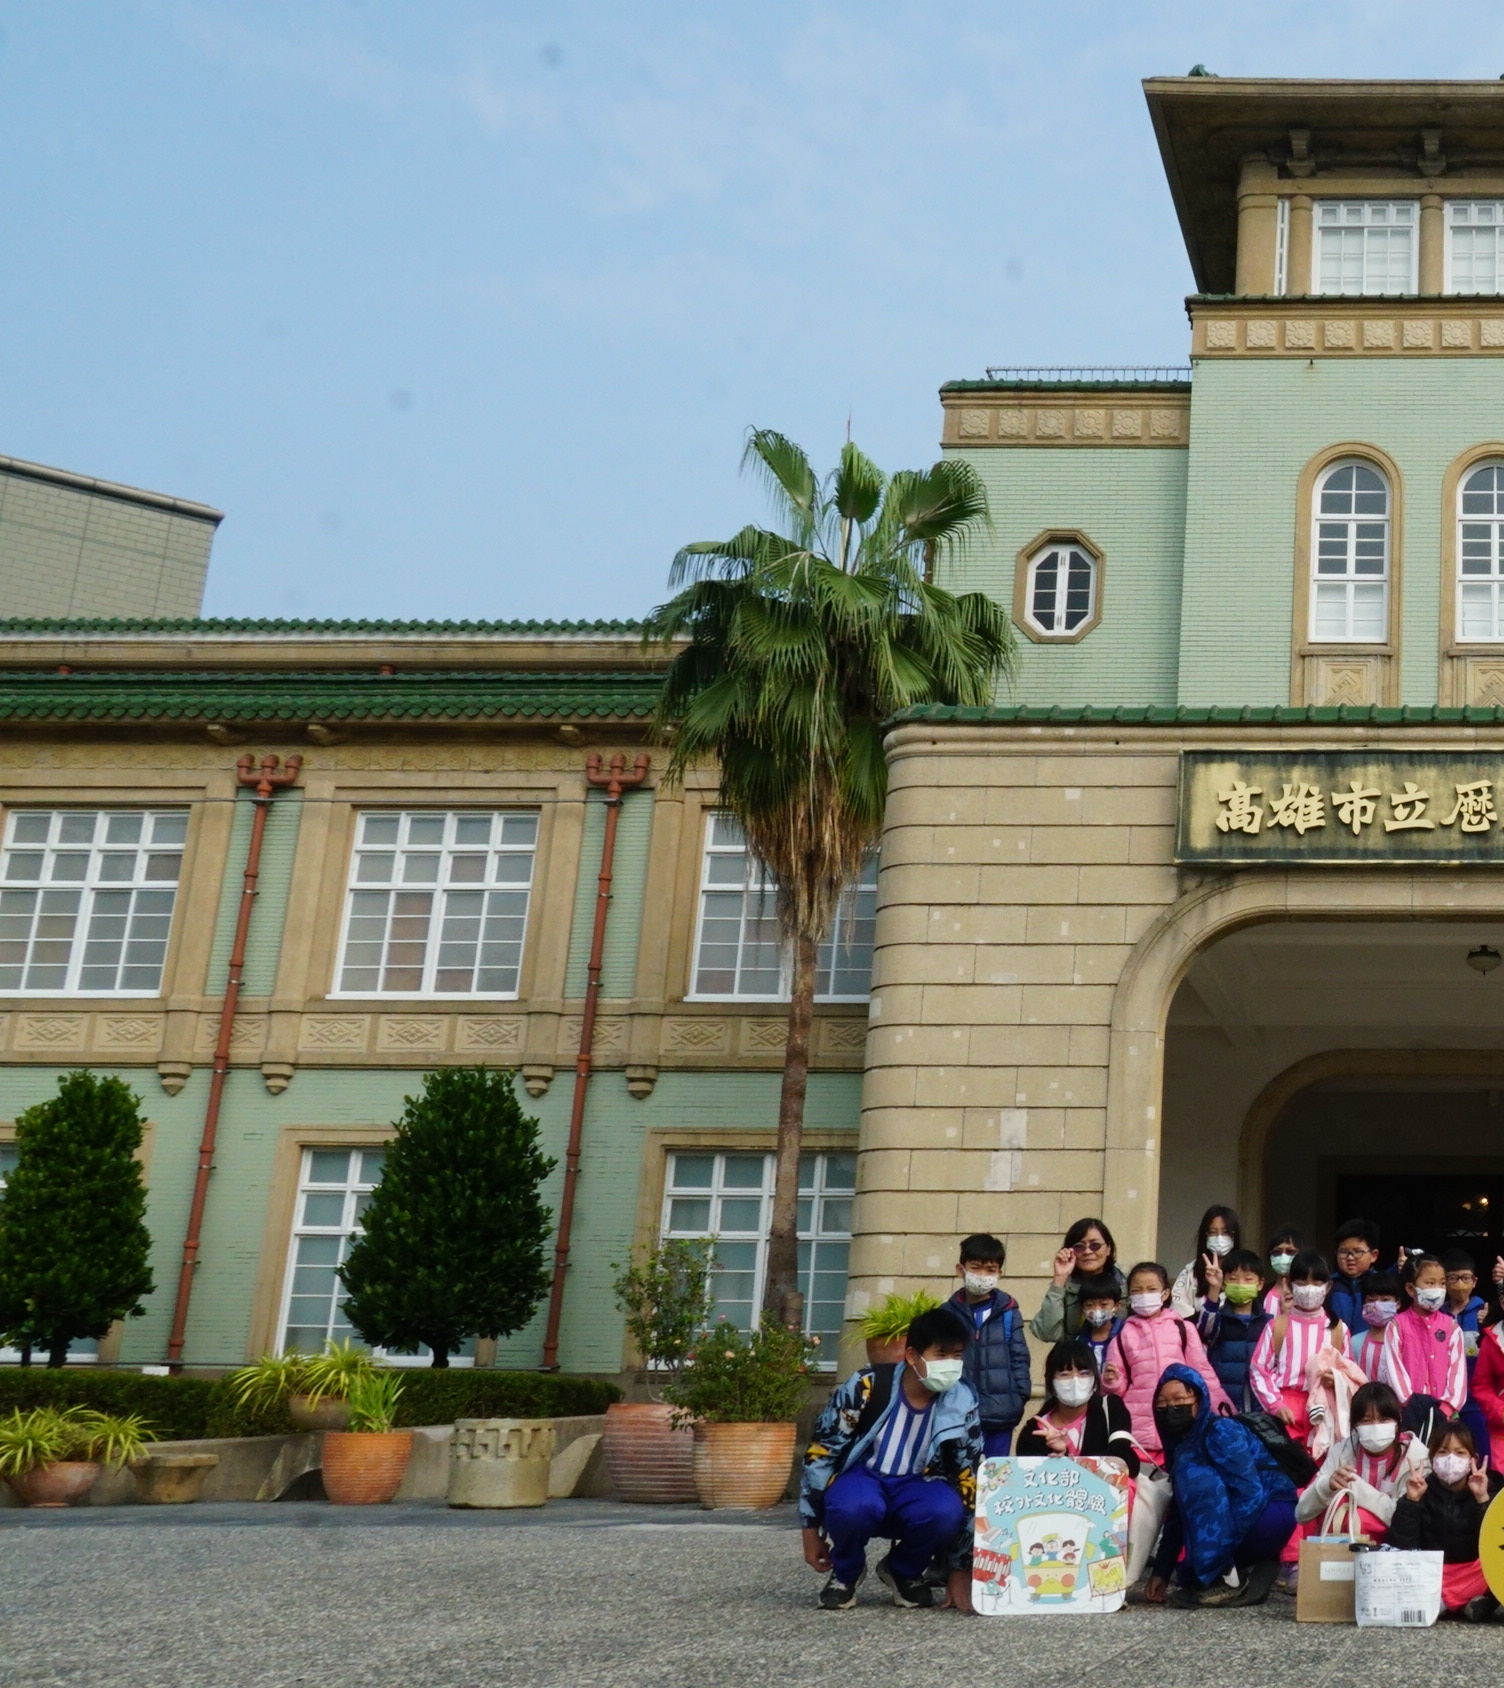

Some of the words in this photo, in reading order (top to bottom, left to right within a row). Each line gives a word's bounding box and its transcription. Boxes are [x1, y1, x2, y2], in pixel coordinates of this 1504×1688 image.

[1023, 1468, 1080, 1488] 文化部
[993, 1488, 1108, 1516] 校外文化體驗
